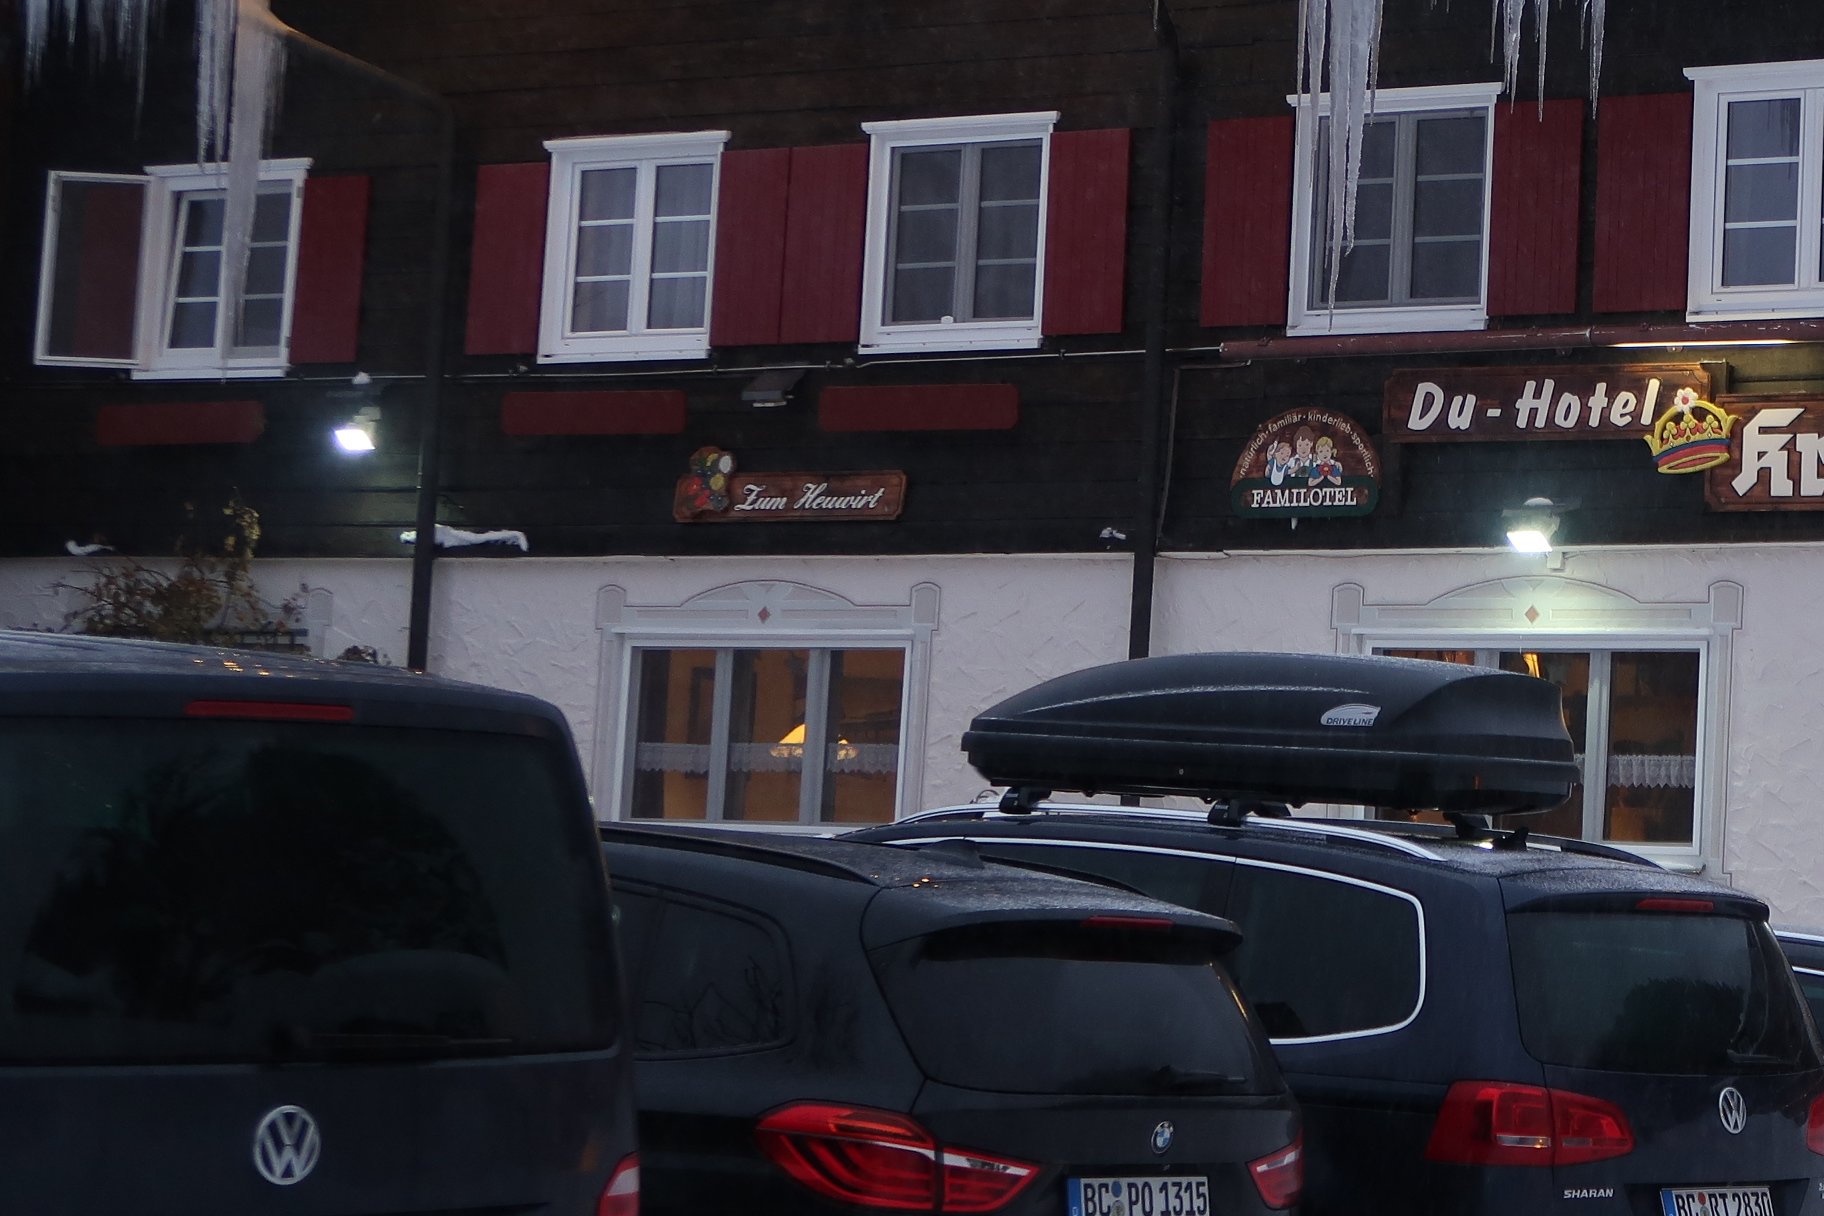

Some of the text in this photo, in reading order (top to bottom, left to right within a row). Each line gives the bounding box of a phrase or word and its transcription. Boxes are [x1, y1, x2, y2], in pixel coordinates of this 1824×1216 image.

[1307, 410, 1351, 434] kinderlieb
[1351, 432, 1374, 475] sportlich
[734, 483, 886, 511] Zum Heuwirt
[1250, 487, 1357, 508] FAMILOTEL
[1326, 717, 1374, 726] DRIVELINE
[1082, 1181, 1208, 1216] BC PO 1315
[1563, 1188, 1614, 1199] SHARAN
[1674, 1194, 1699, 1216] BC
[1731, 1191, 1775, 1216] 2830
